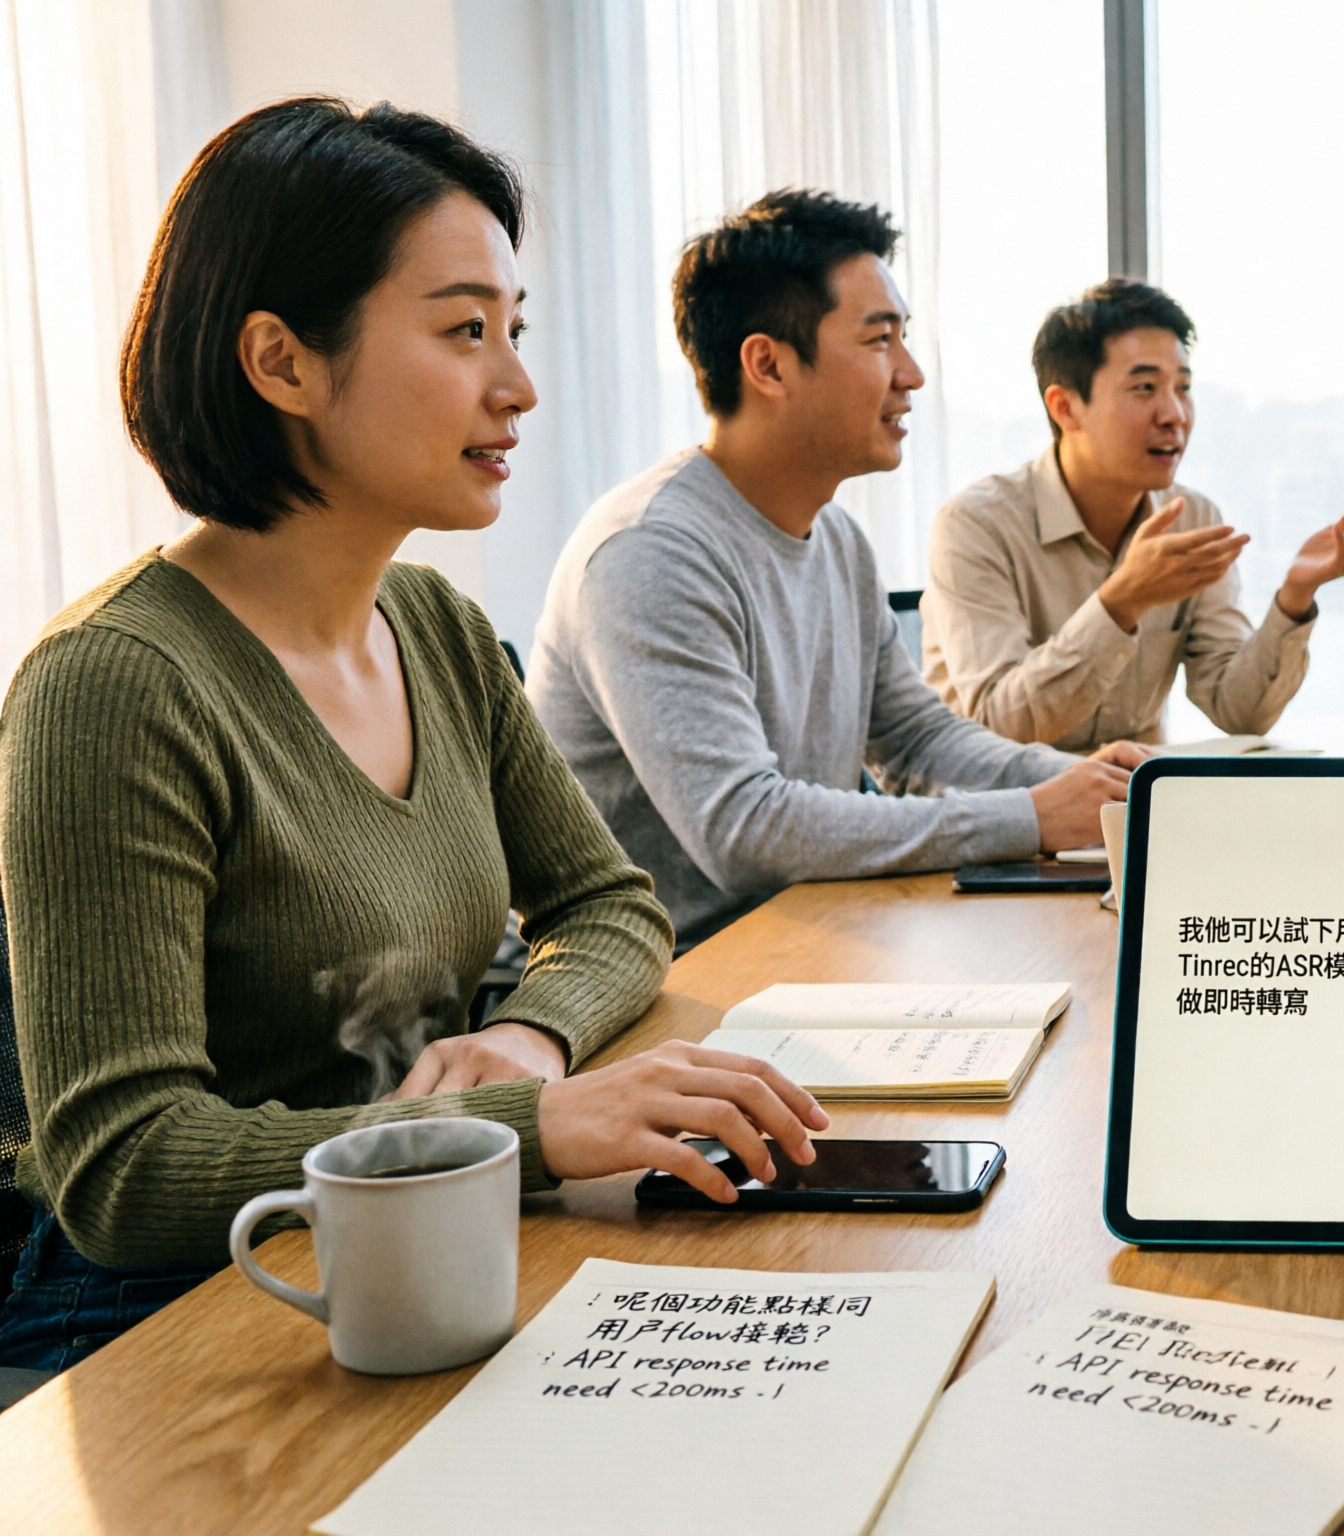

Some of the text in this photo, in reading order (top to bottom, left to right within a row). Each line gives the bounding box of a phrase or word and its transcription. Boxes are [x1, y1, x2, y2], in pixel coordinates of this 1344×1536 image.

[562, 1348, 628, 1369] API
[633, 1357, 751, 1378] response
[763, 1355, 830, 1372] time
[542, 1377, 621, 1399] need
[630, 1381, 745, 1399] <200ms
[1055, 1352, 1334, 1411] API response time
[1027, 1385, 1115, 1406] need
[1123, 1394, 1238, 1427] <200ms
